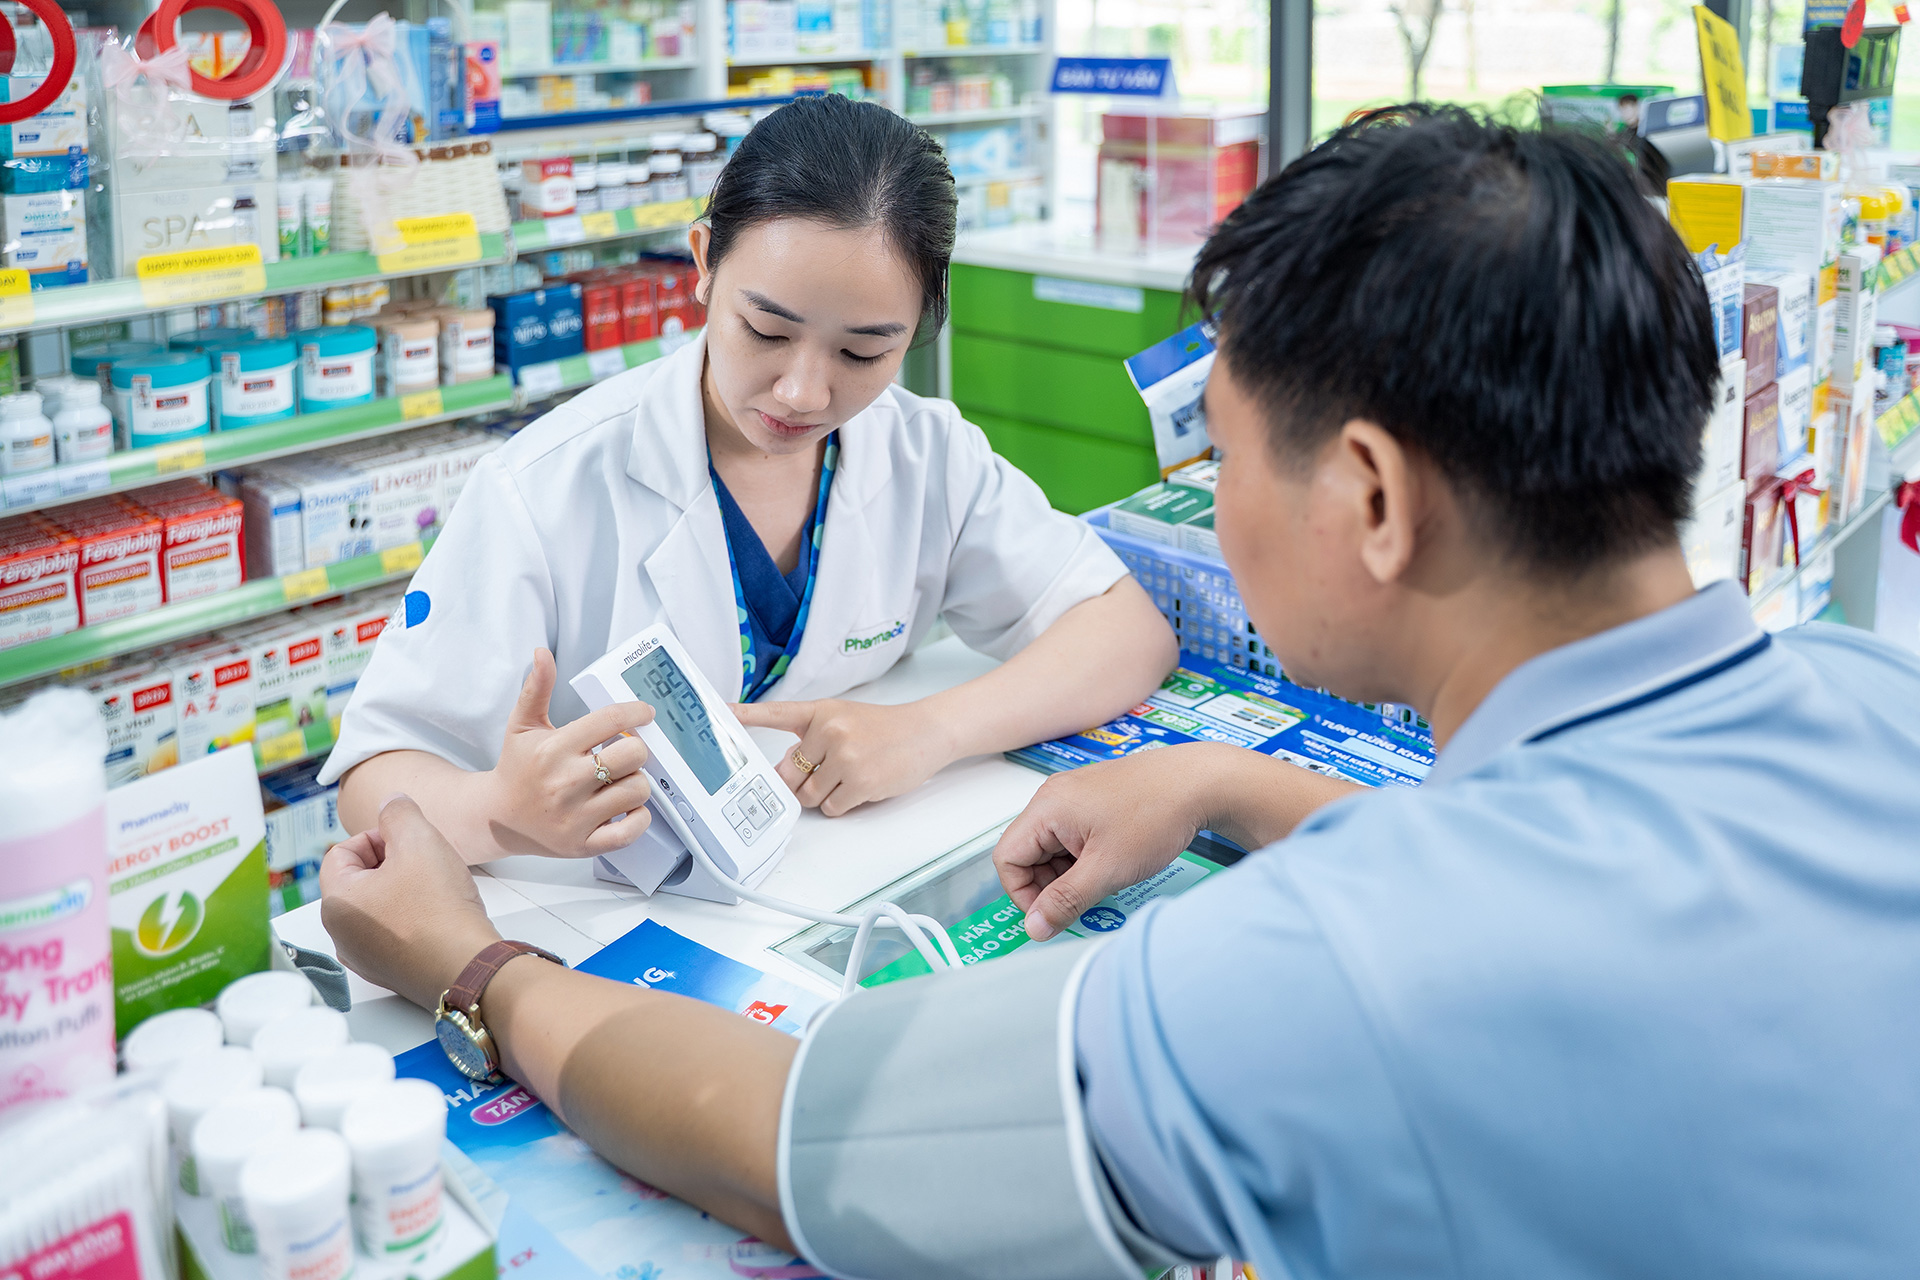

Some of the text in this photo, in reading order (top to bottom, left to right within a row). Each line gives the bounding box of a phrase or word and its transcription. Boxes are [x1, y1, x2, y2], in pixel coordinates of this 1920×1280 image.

[167, 513, 242, 546] Feroglobin
[82, 532, 162, 565] Feroglobin
[623, 640, 653, 665] microlife
[1396, 747, 1434, 766] KHAI
[120, 801, 190, 832] Pharmacity
[168, 817, 232, 848] BOOST
[958, 918, 995, 944] HÃY
[961, 939, 1001, 965] BÁO
[485, 1090, 531, 1118] TẶN
